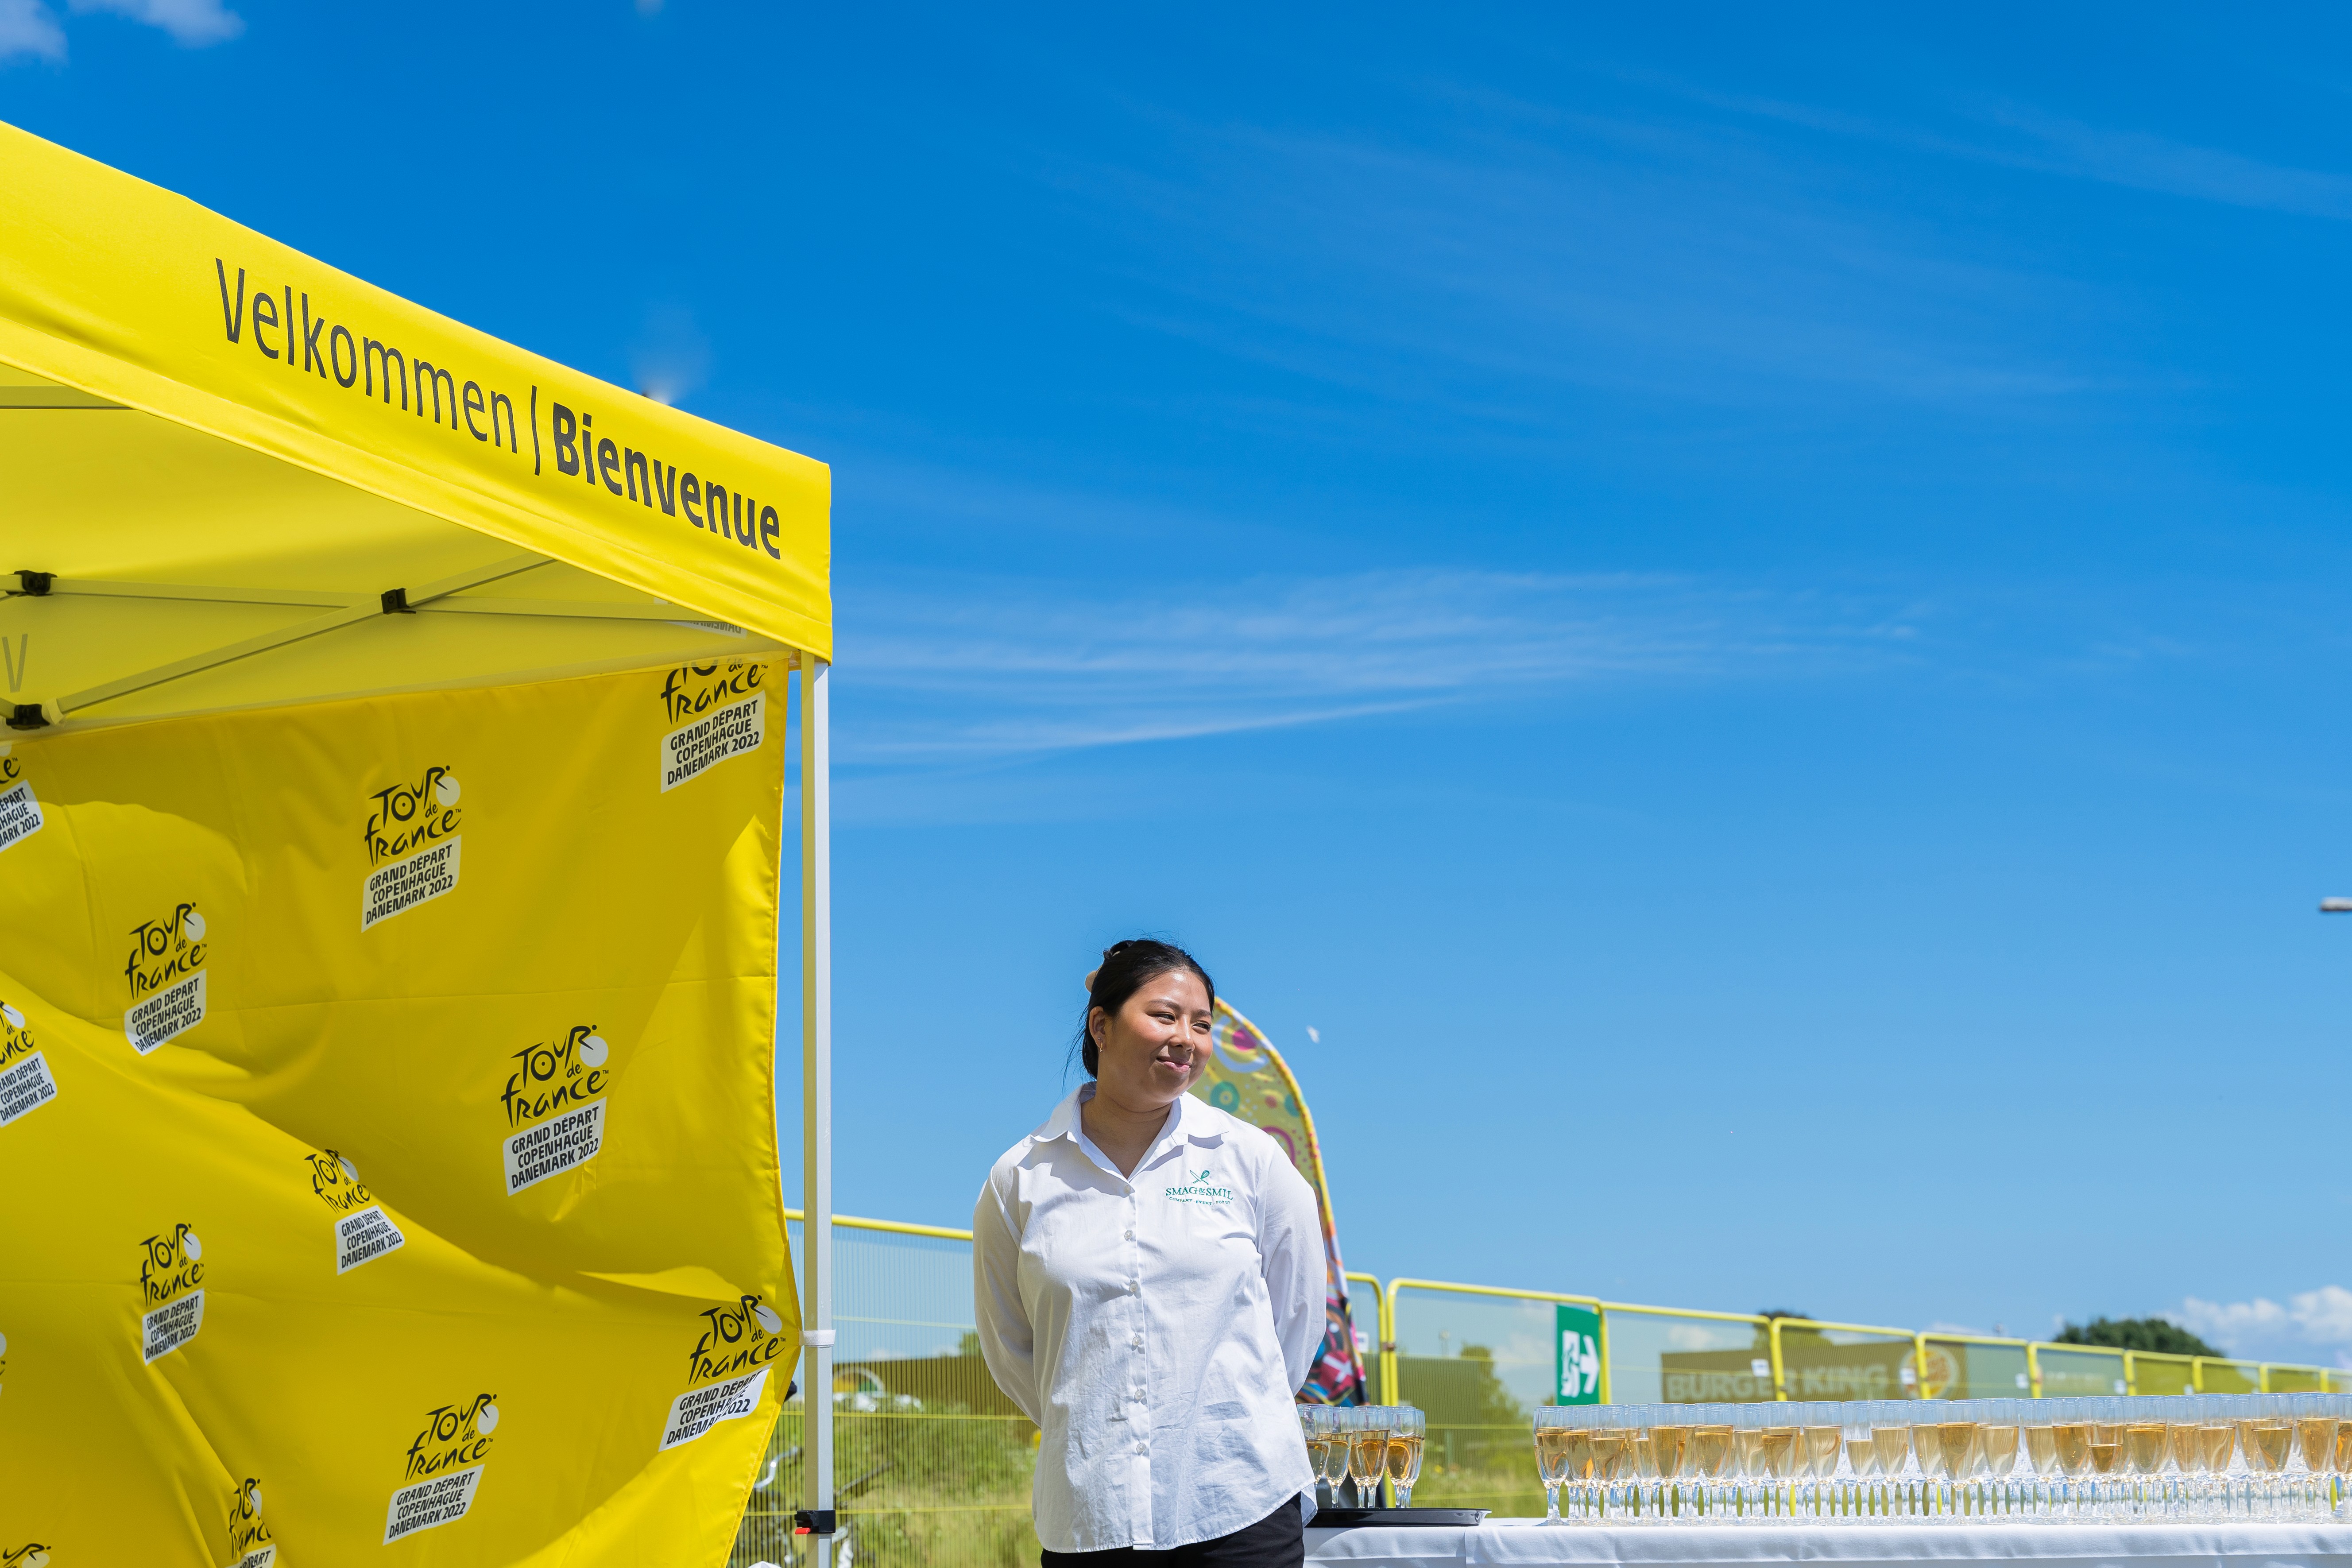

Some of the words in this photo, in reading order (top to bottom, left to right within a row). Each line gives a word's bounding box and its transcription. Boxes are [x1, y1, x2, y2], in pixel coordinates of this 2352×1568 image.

[215, 258, 518, 453] Velkommen
[552, 402, 781, 560] Bienvenue
[661, 665, 765, 724] france
[670, 721, 710, 751] GRAND
[713, 700, 758, 730] DÉPART
[677, 718, 751, 764] COPENHAGUE
[668, 741, 729, 785] DANEMARK
[731, 731, 759, 752] 2022
[0, 803, 29, 830] HAGUE
[369, 767, 448, 829] TOUR
[425, 800, 438, 818] de
[20, 814, 40, 834] 2022
[365, 810, 461, 867] france
[370, 865, 406, 891] GRAND
[410, 844, 452, 874] DÉPART
[373, 863, 446, 904] COPENHAGUE
[367, 886, 426, 925] DANEMARK
[429, 875, 453, 895] 2022
[129, 903, 195, 964] TOUR
[176, 936, 187, 952] de
[125, 945, 207, 999] france
[132, 998, 162, 1024] GRAND
[164, 978, 199, 1007] DÉPART
[136, 995, 195, 1036] COPENHAGUE
[135, 1018, 179, 1052] DANEMARK
[182, 1007, 201, 1028] 2022
[0, 1072, 16, 1092] AND
[15, 1058, 41, 1080] DÉPART
[511, 1026, 594, 1089] TOUR
[567, 1060, 582, 1078] de
[0, 1072, 44, 1105] COPENHAGUE
[0, 1091, 39, 1121] DANEMARK
[38, 1083, 54, 1100] 2022
[501, 1070, 608, 1128] france
[512, 1127, 550, 1154] GRAND
[553, 1106, 599, 1137] DÉPART
[518, 1124, 593, 1168] COPENHAGUE
[304, 1149, 348, 1189] TOUR
[512, 1149, 575, 1189] DANEMARK
[578, 1138, 599, 1161] 2022
[313, 1174, 370, 1214] france
[341, 1217, 364, 1236] GRAND
[365, 1210, 383, 1225] DÉPART
[347, 1221, 391, 1250] COPENHAGUE
[139, 1223, 192, 1274] TOUR
[179, 1252, 188, 1268] de
[341, 1237, 386, 1268] DANEMARK
[140, 1259, 205, 1307] france
[147, 1309, 169, 1330] GRAND
[171, 1295, 198, 1319] DÉPART
[151, 1312, 194, 1343] COPENHAGUE
[698, 1295, 768, 1349] TOUR
[146, 1332, 178, 1360] DANEMARK
[180, 1324, 197, 1341] 2022
[751, 1325, 763, 1343] de
[689, 1332, 785, 1385] france
[679, 1387, 719, 1411] GRAND
[426, 1394, 489, 1446] TOUR
[462, 1425, 475, 1442] de
[405, 1430, 491, 1481] france
[397, 1484, 432, 1506] GRAND
[433, 1471, 475, 1495] DÉPART
[398, 1489, 464, 1520] COPENHAGUE
[389, 1509, 442, 1539] DANEMARK
[442, 1502, 466, 1520] 2022
